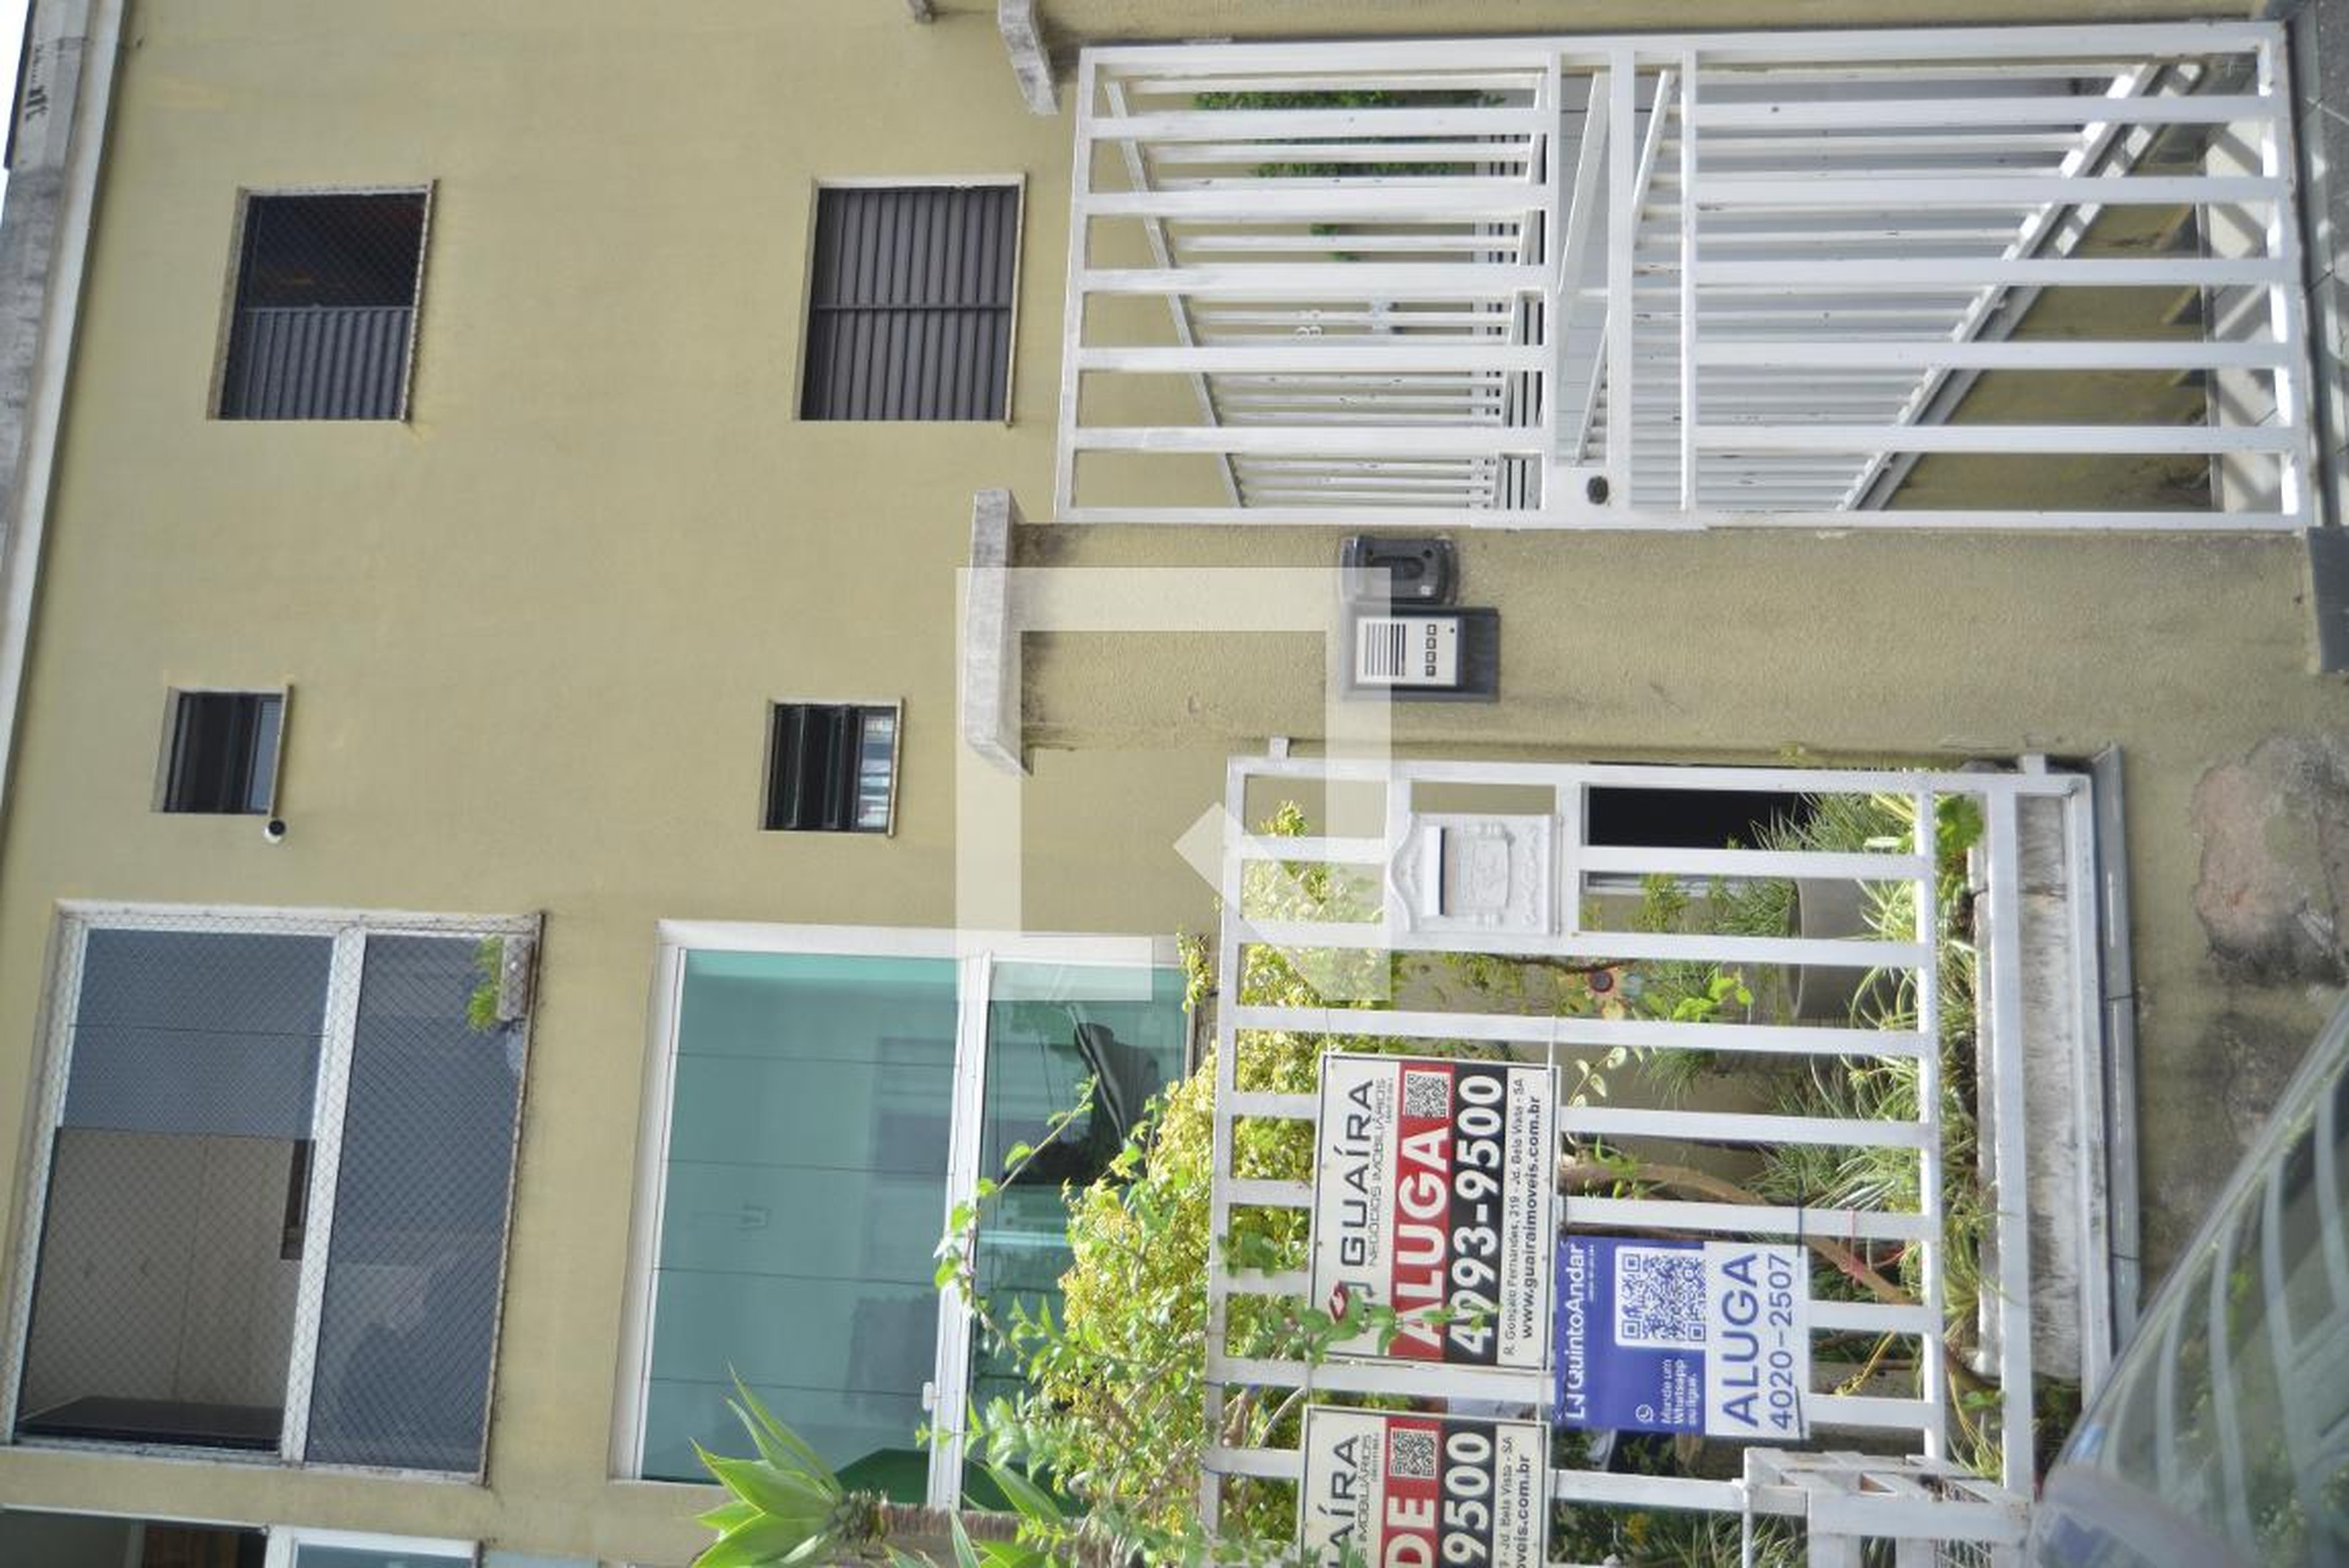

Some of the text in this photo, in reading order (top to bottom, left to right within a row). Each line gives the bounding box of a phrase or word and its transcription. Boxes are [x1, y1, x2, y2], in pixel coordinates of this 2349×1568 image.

[1333, 1079, 1373, 1266] GUAÍRA
[1367, 1078, 1387, 1267] NEGÓCIOS IMOBILIÁRIOS
[1513, 1078, 1524, 1095] SA
[1394, 1127, 1449, 1348] ALUGA
[1449, 1075, 1503, 1354] 4993-9500
[1521, 1096, 1540, 1339] www.guairaimoveis.com.br
[1564, 1243, 1585, 1389] QuintoAndar
[1661, 1359, 1672, 1424] Mande um
[1721, 1253, 1759, 1428] ALUGA
[1768, 1252, 1794, 1430] 4020-2507
[1318, 1435, 1359, 1568] AÍRA
[1502, 1437, 1512, 1454] SA
